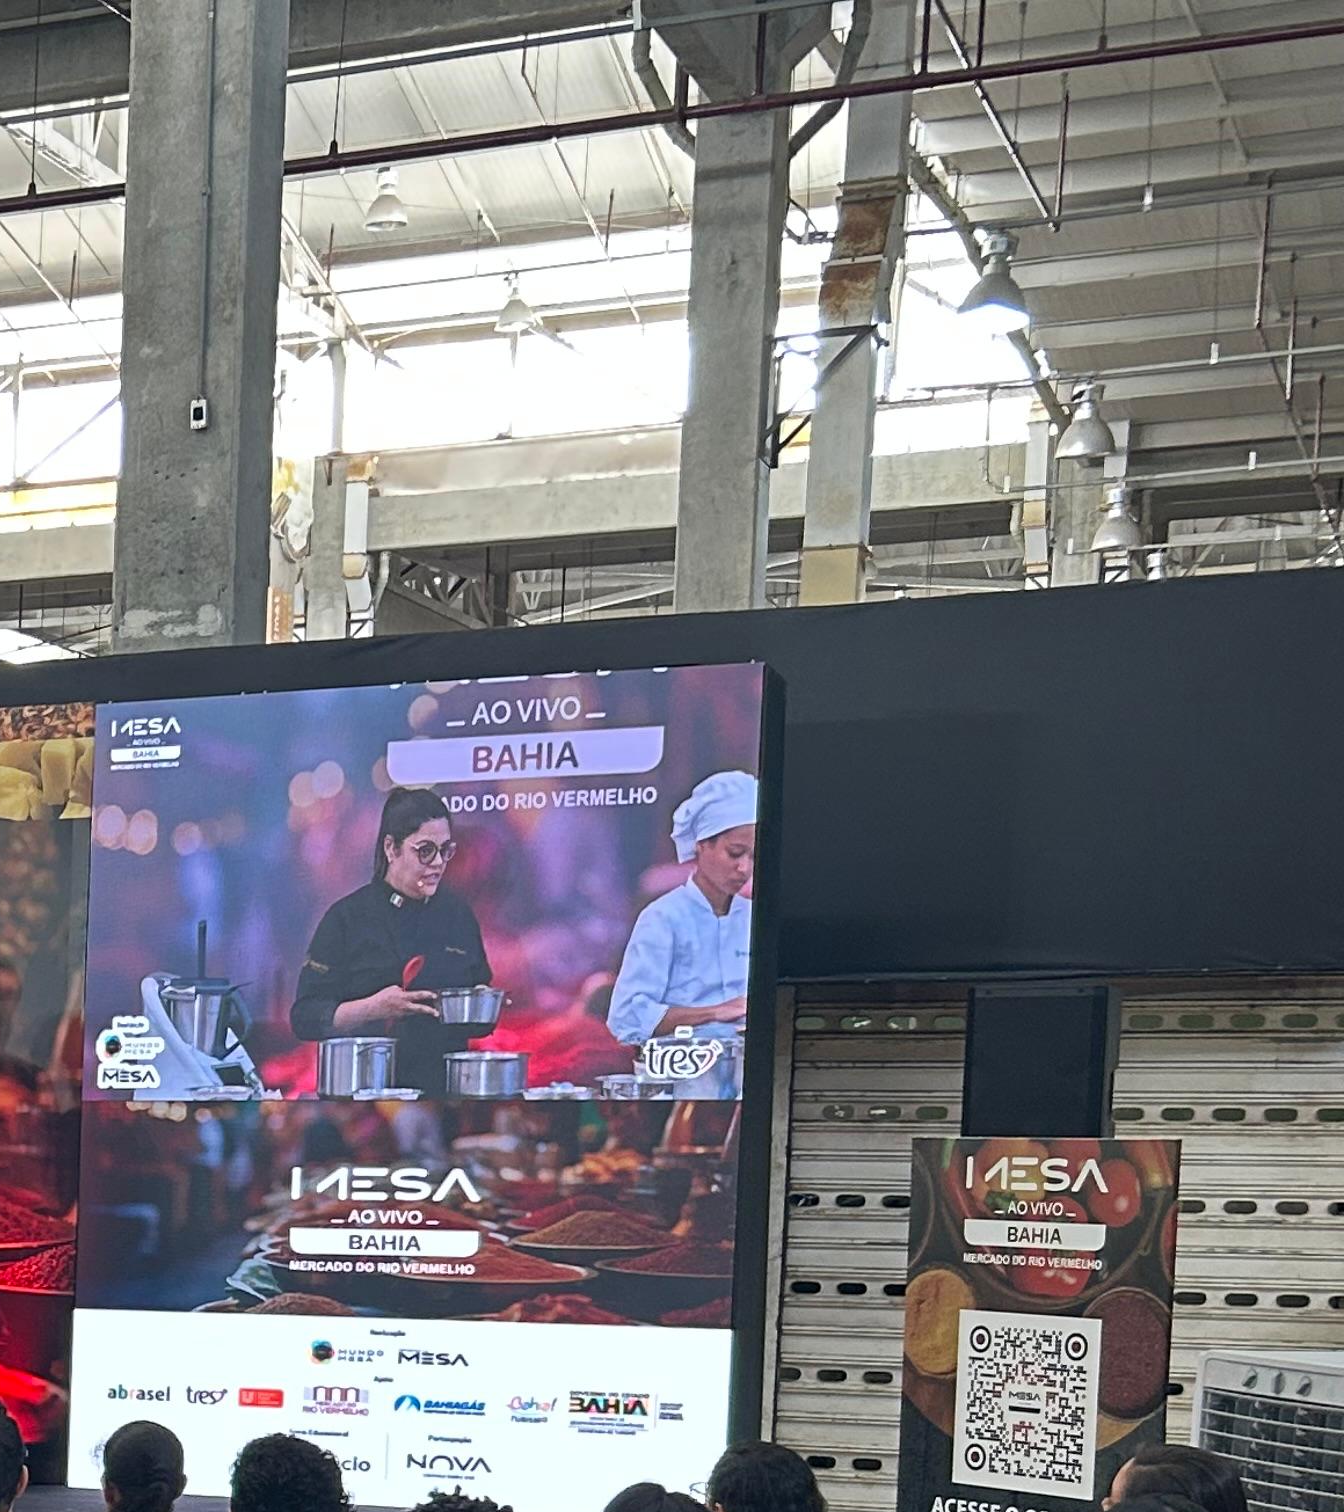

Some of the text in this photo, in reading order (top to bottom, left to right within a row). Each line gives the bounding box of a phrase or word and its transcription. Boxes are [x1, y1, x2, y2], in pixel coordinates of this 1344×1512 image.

[471, 696, 581, 726] AO VIVO
[111, 716, 181, 738] MESA
[471, 741, 579, 773] BAHIA
[482, 792, 510, 811] DO
[514, 791, 546, 810] RIO
[551, 786, 658, 808] VERMELHO
[102, 1070, 156, 1083] MESA
[965, 1155, 1109, 1193] MESA
[291, 1166, 481, 1203] MESA
[347, 1209, 423, 1225] AO VIVO
[1007, 1201, 1063, 1216] AO VIVO
[348, 1234, 421, 1252] BAHIA
[1007, 1226, 1062, 1245] BAHIA
[289, 1259, 476, 1276] MERCADO DO RIO VERMELHO
[963, 1252, 1103, 1271] MERCADO DO RIO VERMELHO
[398, 1350, 469, 1367] MESA
[107, 1384, 171, 1402] abrasel
[568, 1396, 649, 1417] BAHIA
[406, 1453, 492, 1473] NOVA
